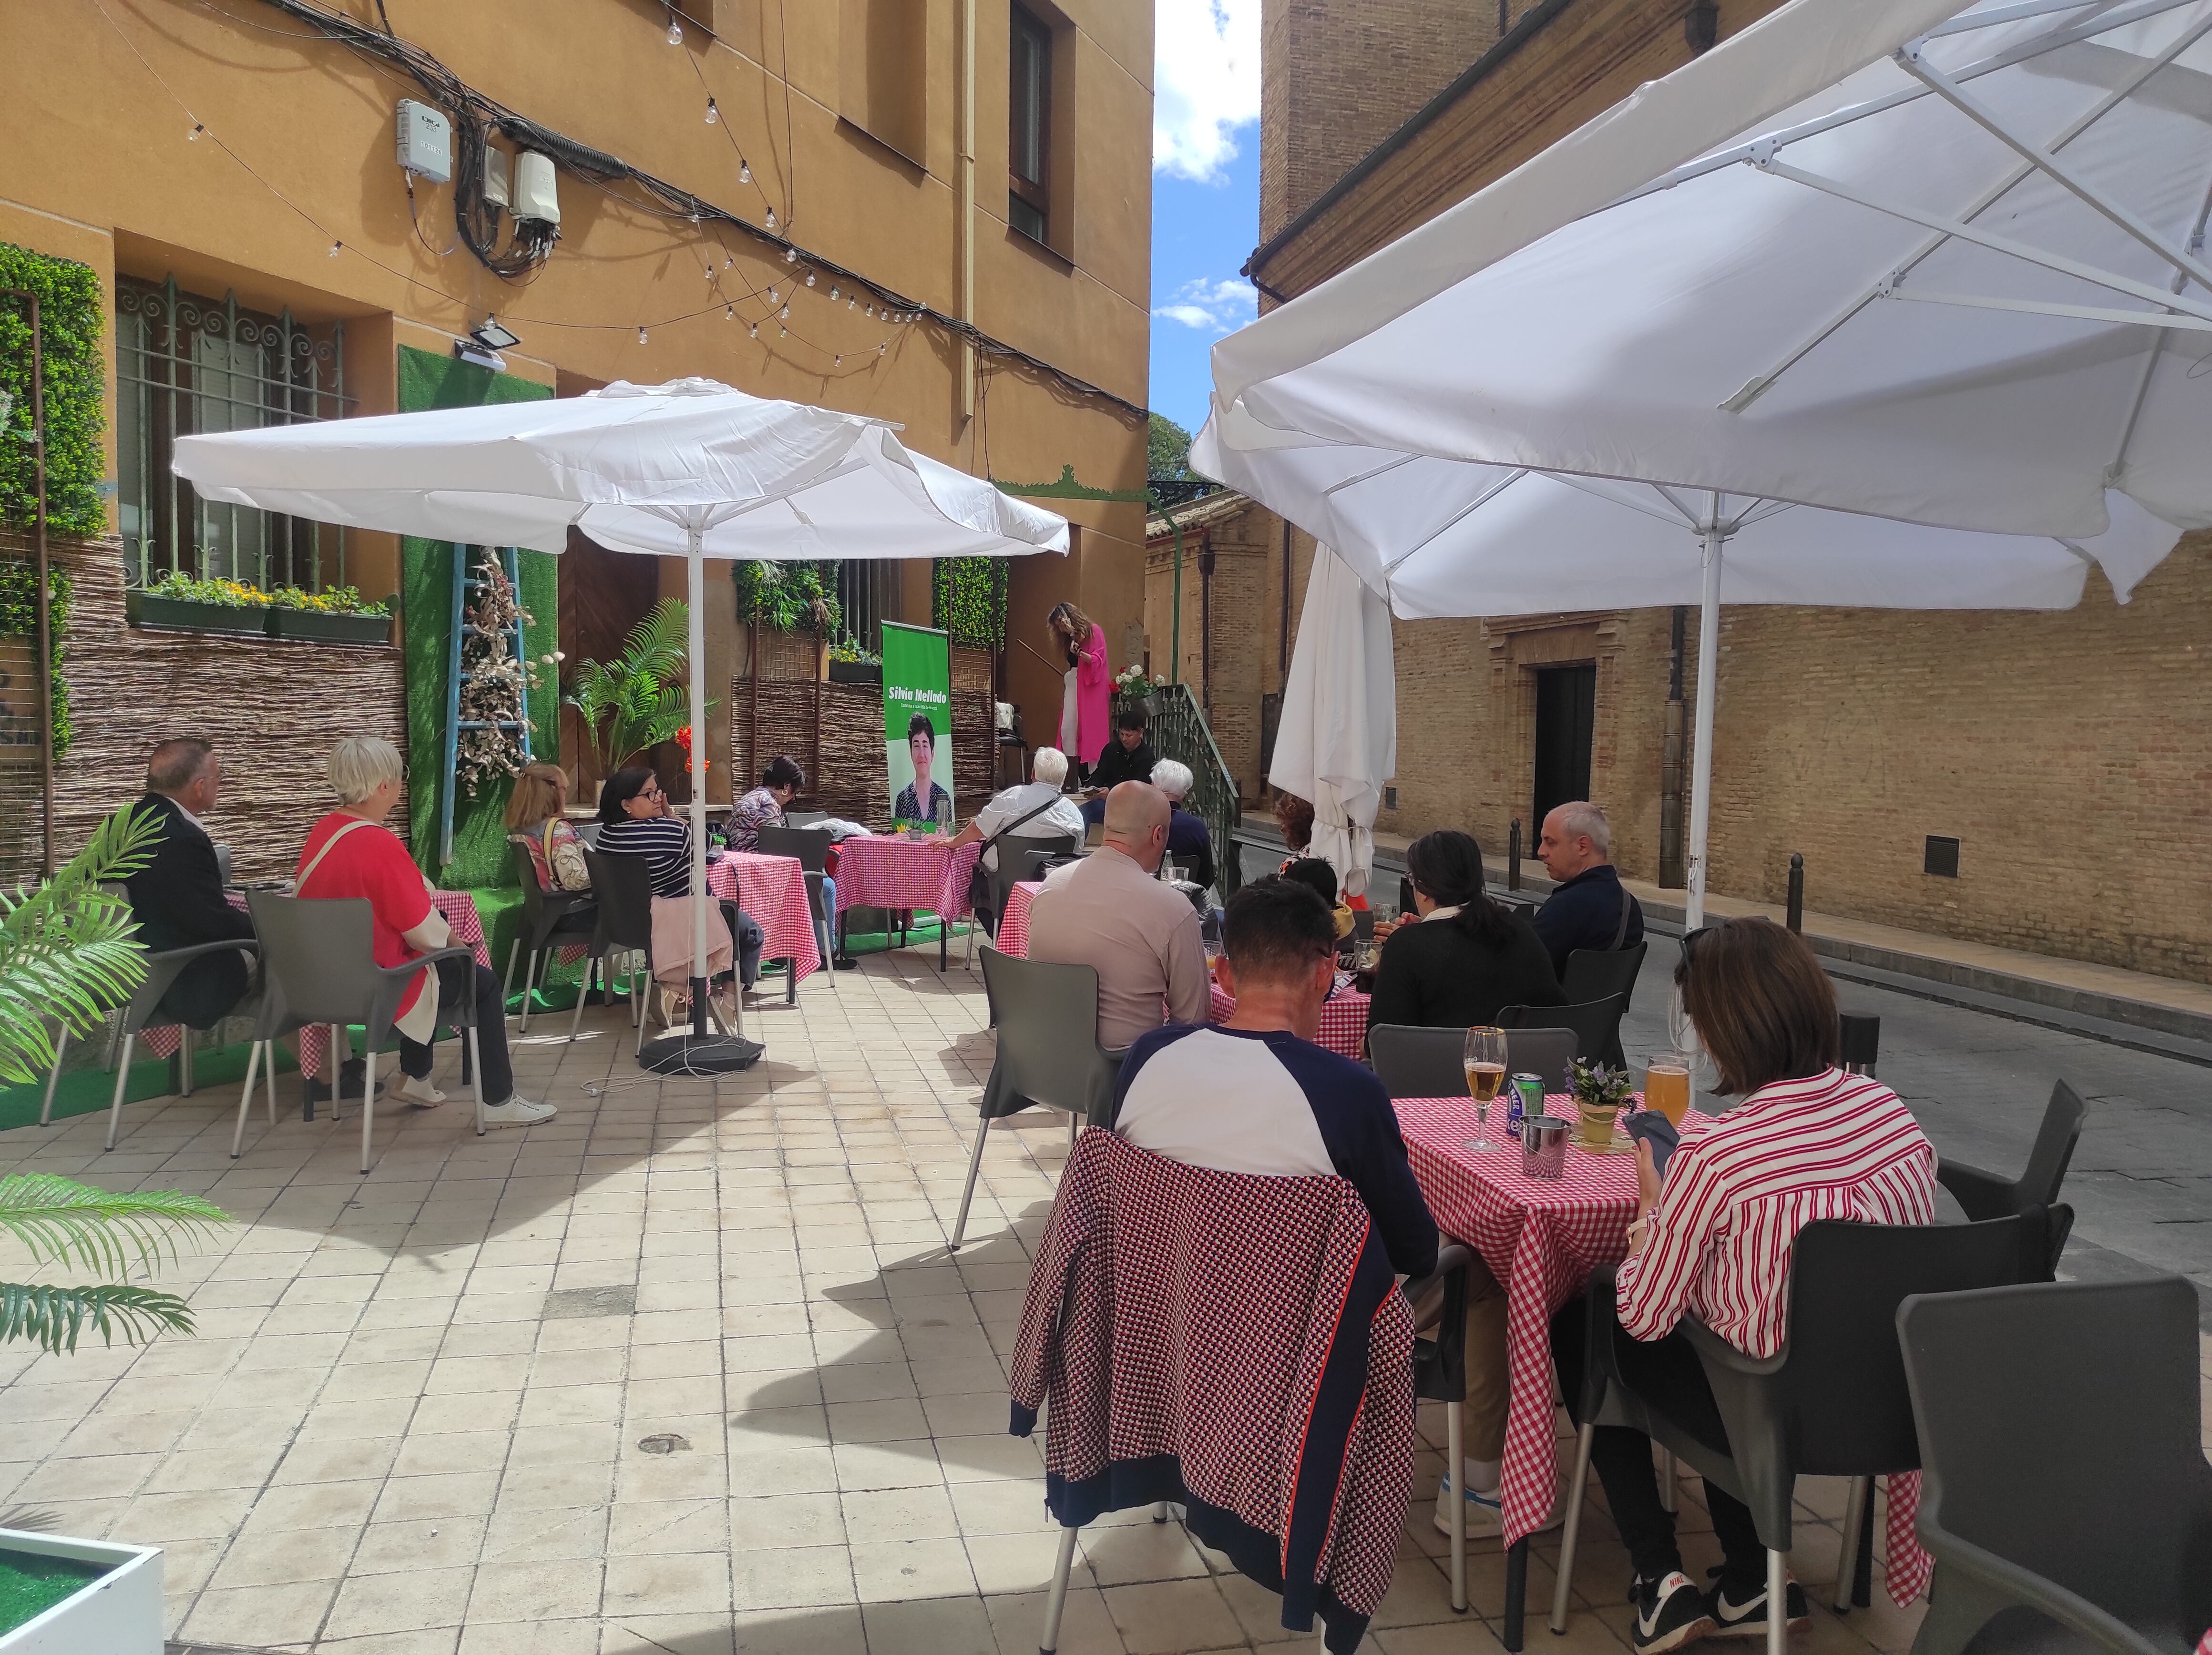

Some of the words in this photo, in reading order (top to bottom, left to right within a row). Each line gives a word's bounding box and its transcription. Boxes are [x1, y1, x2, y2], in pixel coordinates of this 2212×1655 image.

[426, 123, 436, 133] 233
[889, 686, 913, 701] Silvia
[915, 689, 946, 704] Mellado
[1510, 1088, 1520, 1110] BEER
[1669, 1574, 1684, 1588] NIKE
